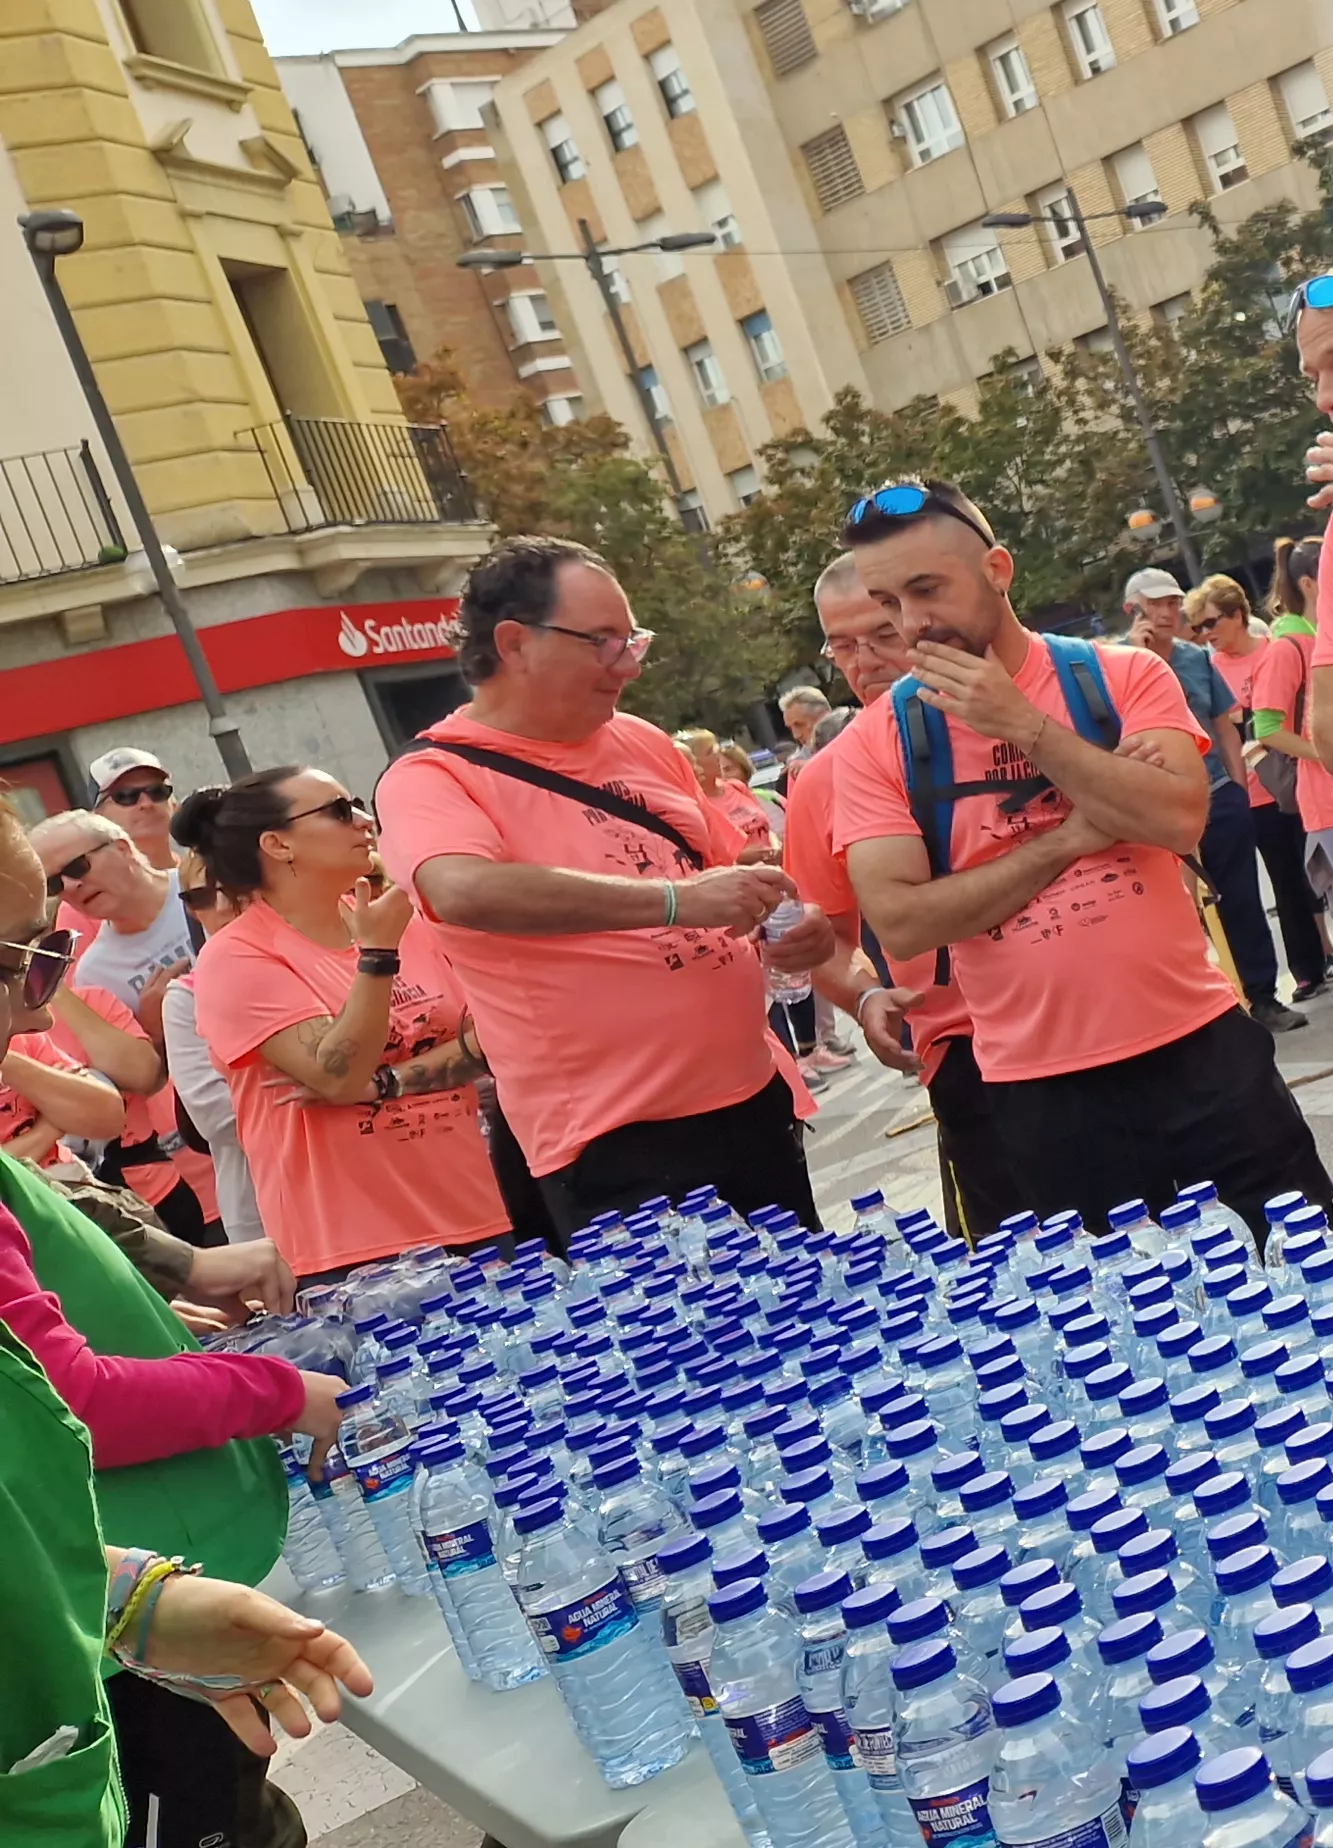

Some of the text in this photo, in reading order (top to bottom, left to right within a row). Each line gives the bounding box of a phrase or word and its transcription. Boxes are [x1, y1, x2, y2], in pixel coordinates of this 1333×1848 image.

[583, 1602, 620, 1628] NATURAL
[938, 1793, 988, 1820] MINERAL
[930, 1812, 979, 1832] NATURAL
